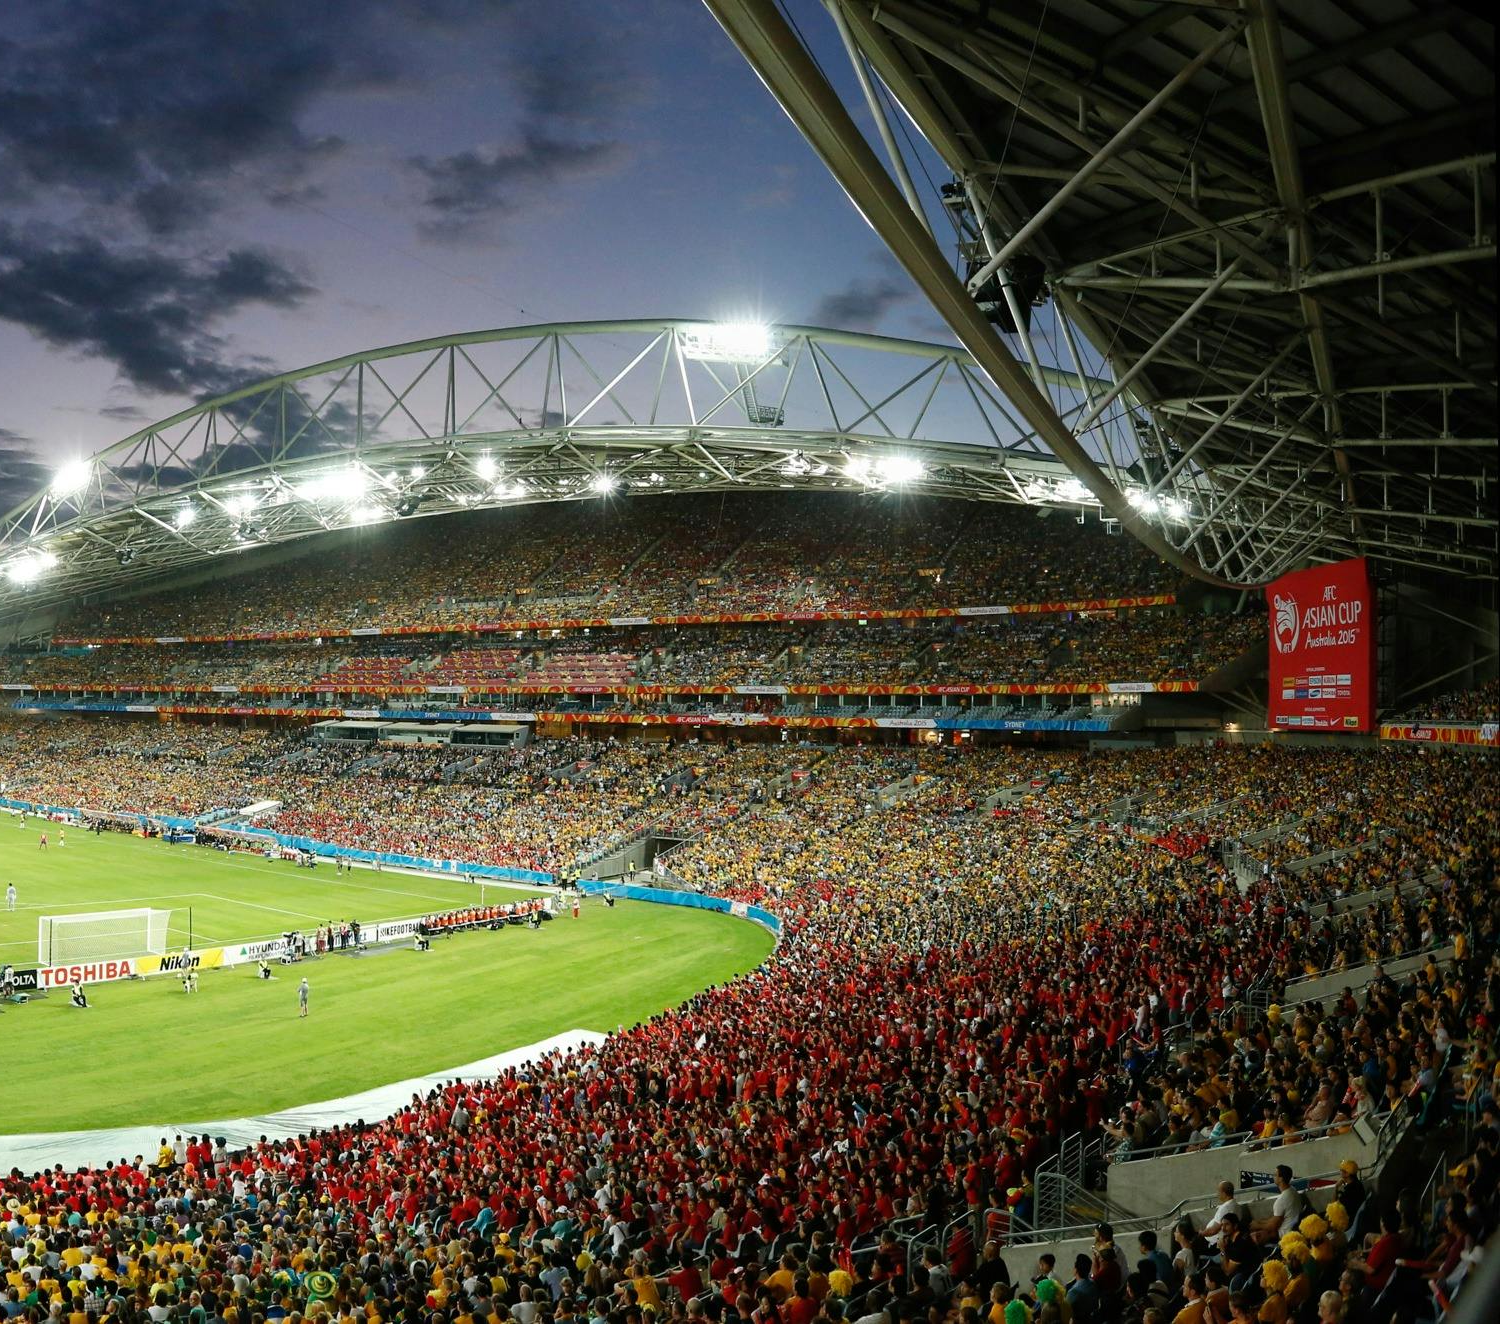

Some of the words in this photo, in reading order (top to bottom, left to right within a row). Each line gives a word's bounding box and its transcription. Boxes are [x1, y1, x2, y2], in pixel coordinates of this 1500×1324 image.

[1322, 585, 1336, 601] AFC
[1302, 605, 1336, 629] ASIAN
[1339, 601, 1362, 624] CUP
[1305, 631, 1336, 650] Australia
[1338, 629, 1356, 644] 2015
[248, 940, 287, 954] HYUNDA
[41, 961, 131, 986] TOSHIBA
